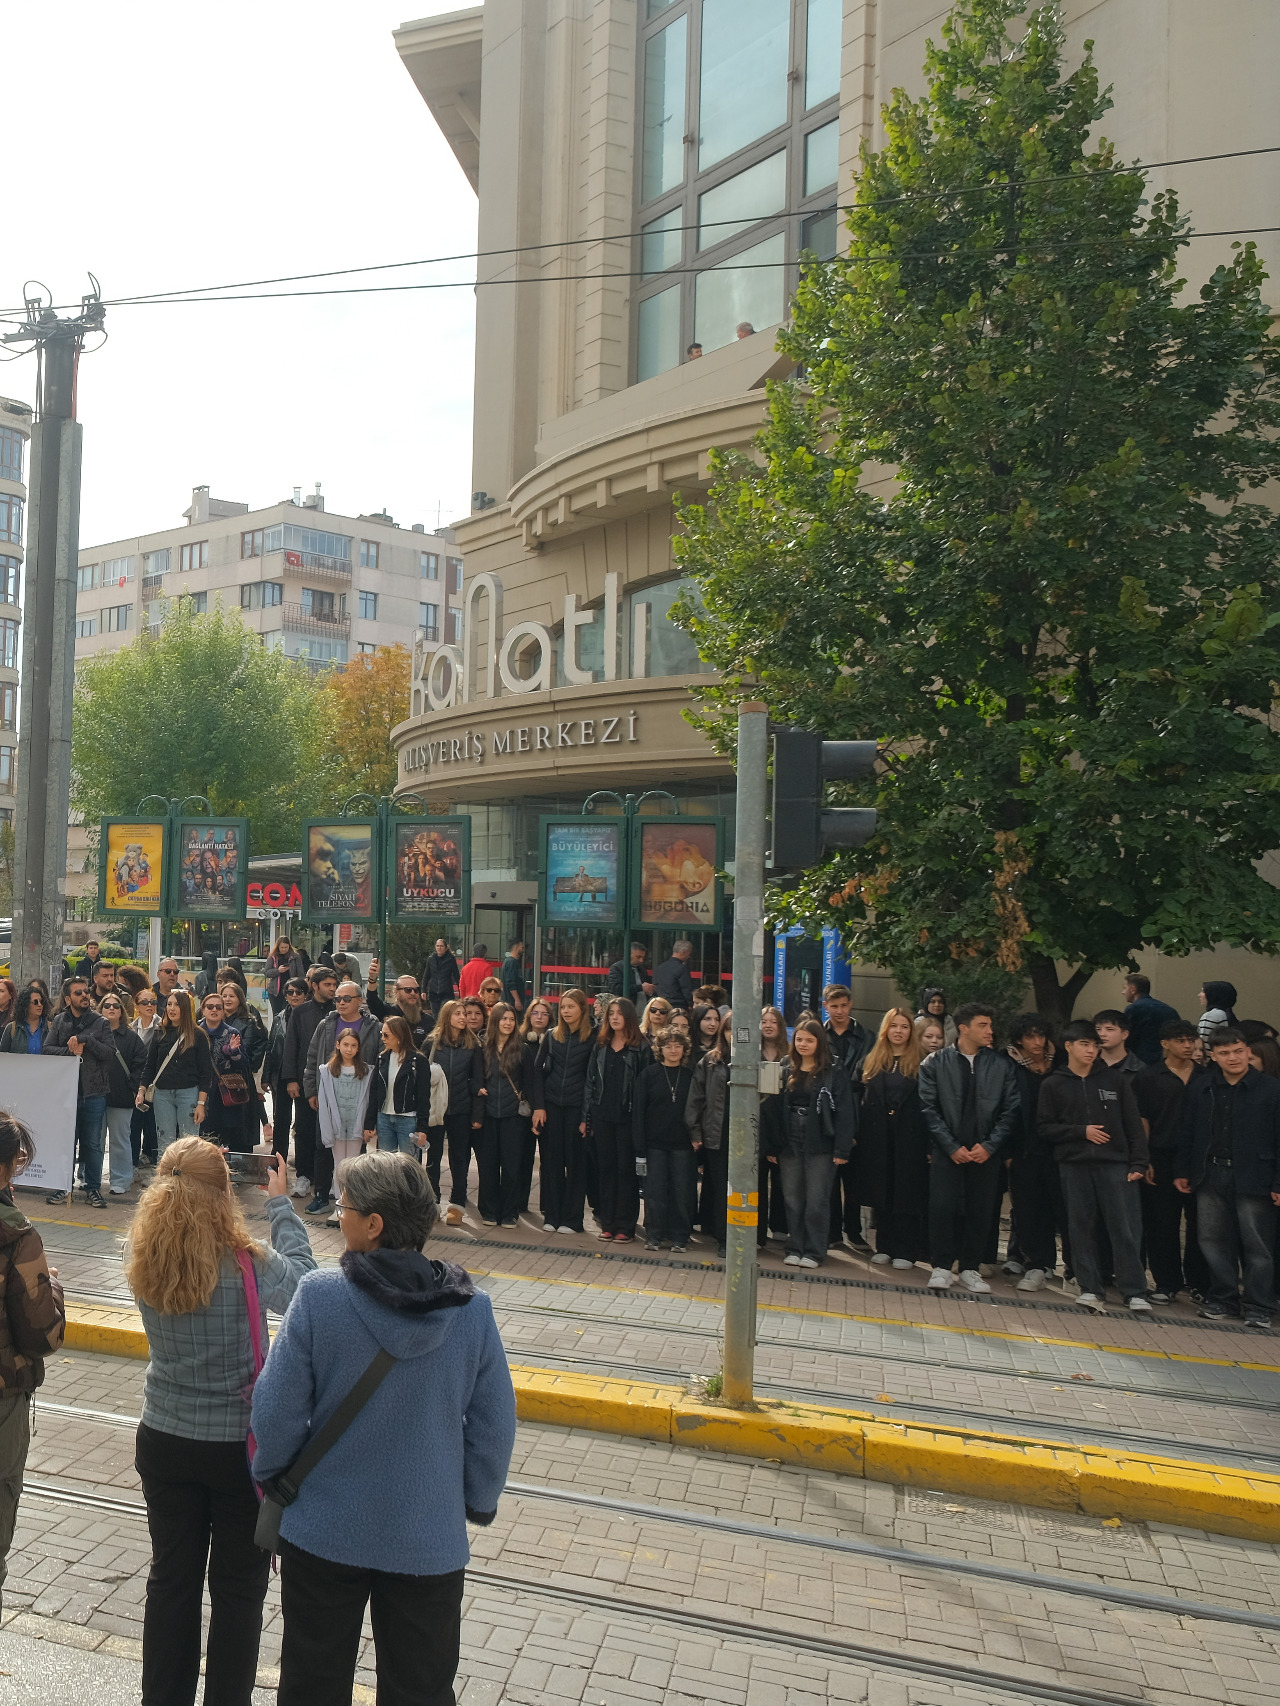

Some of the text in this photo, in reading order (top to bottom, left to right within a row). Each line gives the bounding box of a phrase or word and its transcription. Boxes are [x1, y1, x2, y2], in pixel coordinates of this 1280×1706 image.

[404, 710, 638, 772] ALIŞVERİŞ MERKEZİ
[551, 841, 613, 851] BÜYÜLEYİCİ
[330, 893, 356, 901] SİYAH
[403, 887, 455, 898] UYKUCU
[317, 893, 366, 908] TELEFON 2
[824, 951, 833, 986] YUNLARI
